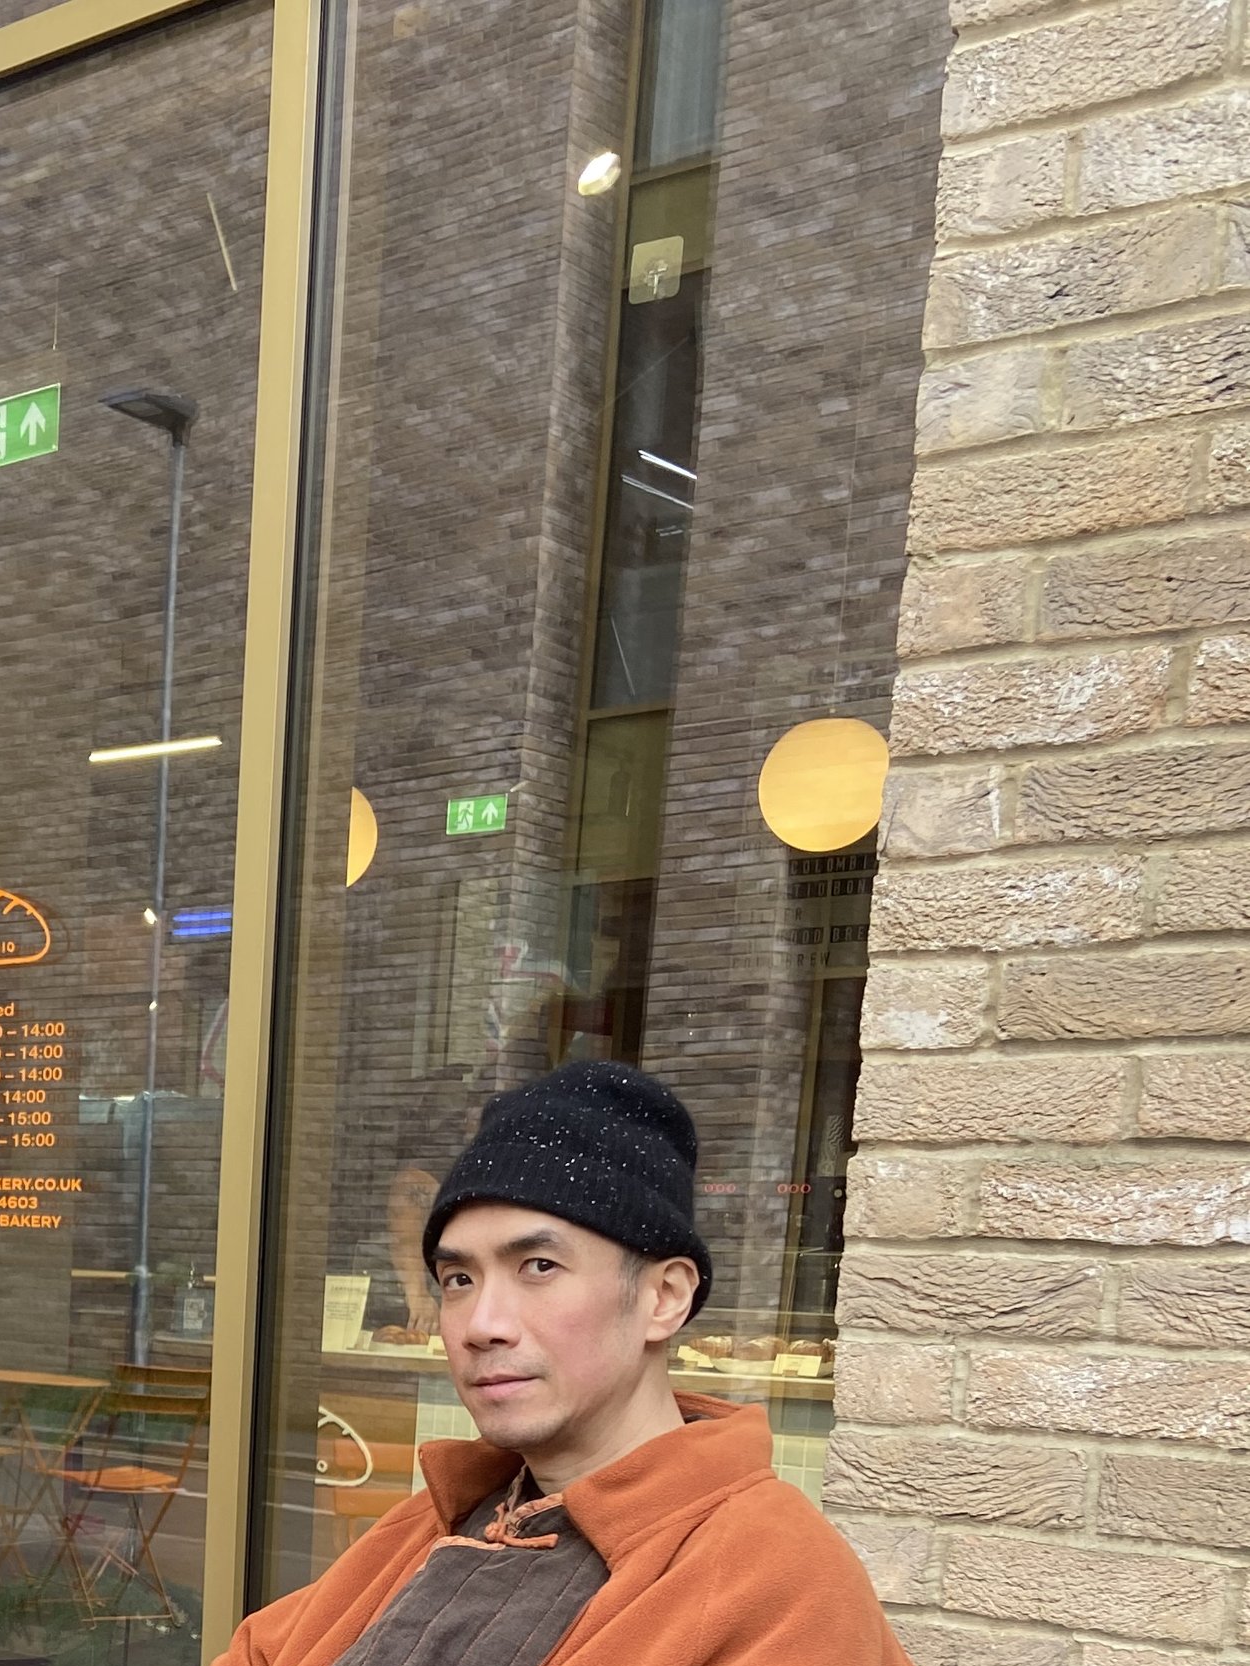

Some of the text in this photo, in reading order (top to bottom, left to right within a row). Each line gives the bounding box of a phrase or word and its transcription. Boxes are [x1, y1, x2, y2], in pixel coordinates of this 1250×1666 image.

[790, 855, 867, 875] COLOMBI
[21, 1022, 65, 1038] 14:00
[20, 1045, 64, 1060] 14:00
[19, 1066, 63, 1082] 14:00
[3, 1090, 46, 1105] 14:00
[8, 1111, 52, 1126] 15:00
[12, 1132, 56, 1147] 15:00
